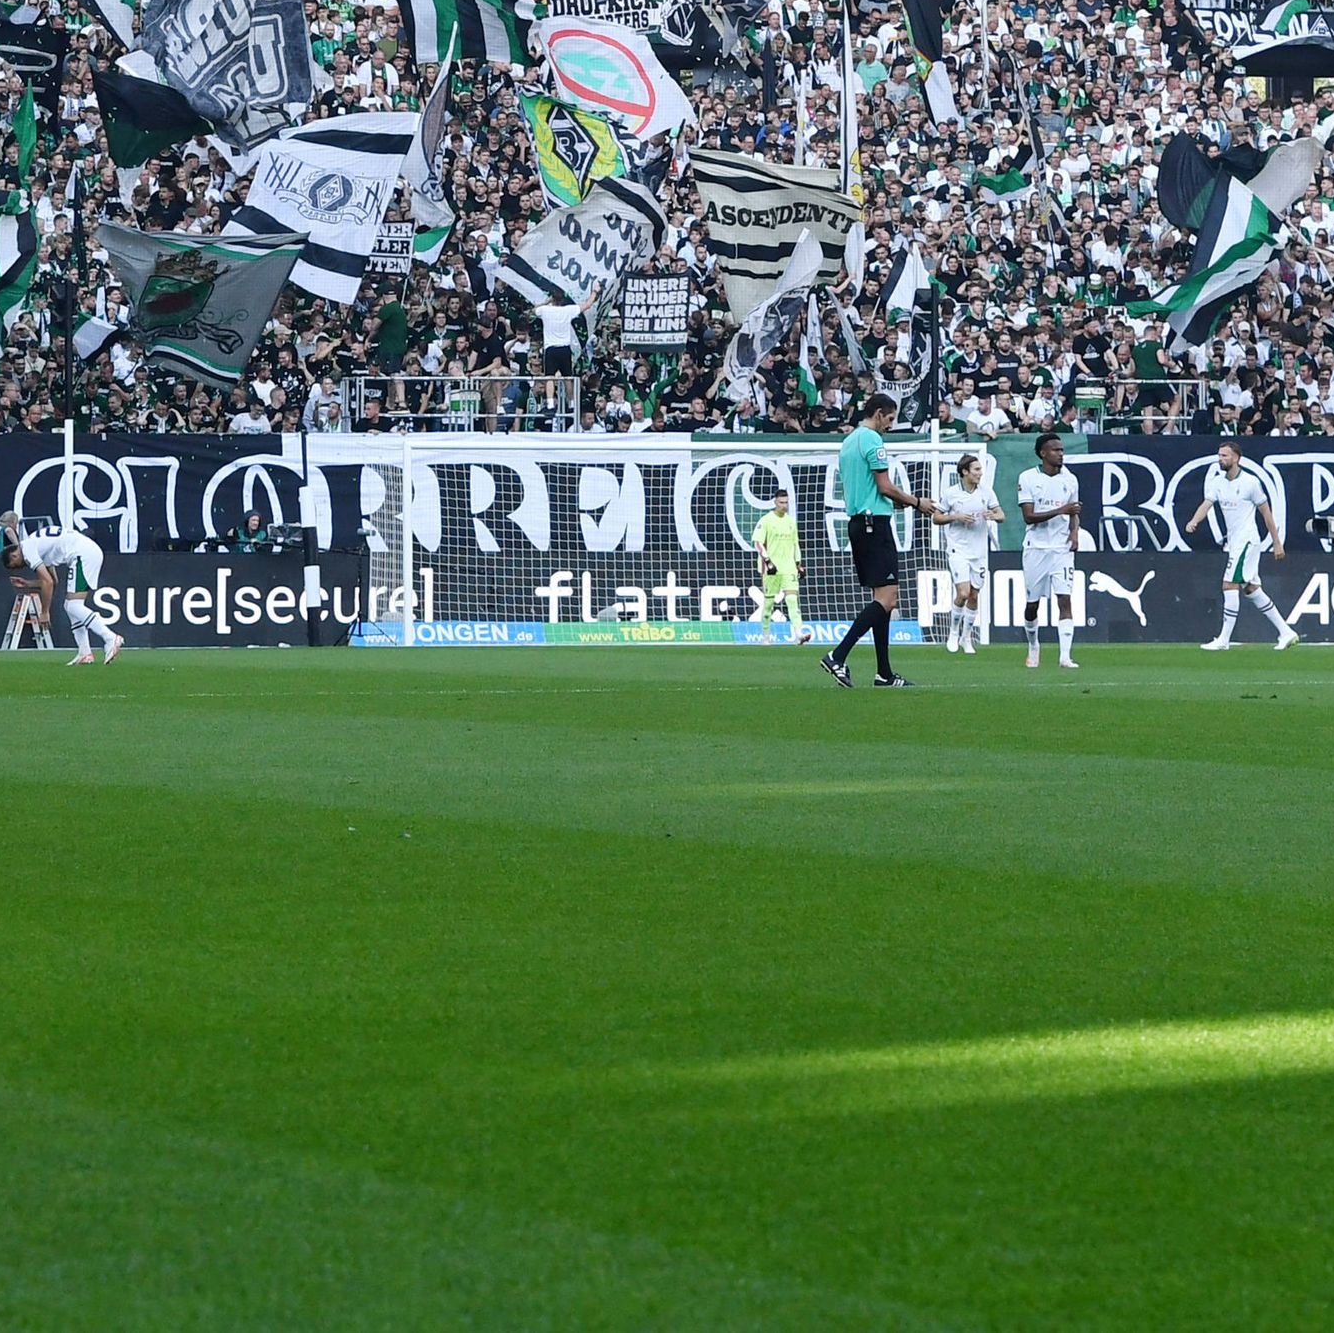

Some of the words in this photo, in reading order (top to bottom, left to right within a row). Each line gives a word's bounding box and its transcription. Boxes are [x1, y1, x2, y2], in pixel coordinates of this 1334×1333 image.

[1195, 9, 1309, 43] FOHLN
[627, 277, 688, 292] UNSERE
[624, 290, 687, 305] BRÜDER
[624, 304, 686, 318] IMMER
[624, 318, 649, 331] BEI
[654, 318, 686, 331] UNS
[92, 568, 434, 634] sure[secure]
[534, 570, 794, 622] flatex
[409, 623, 509, 643] JONGEN
[514, 630, 533, 642] .de
[680, 631, 700, 640] .de
[785, 624, 859, 644] JONG
